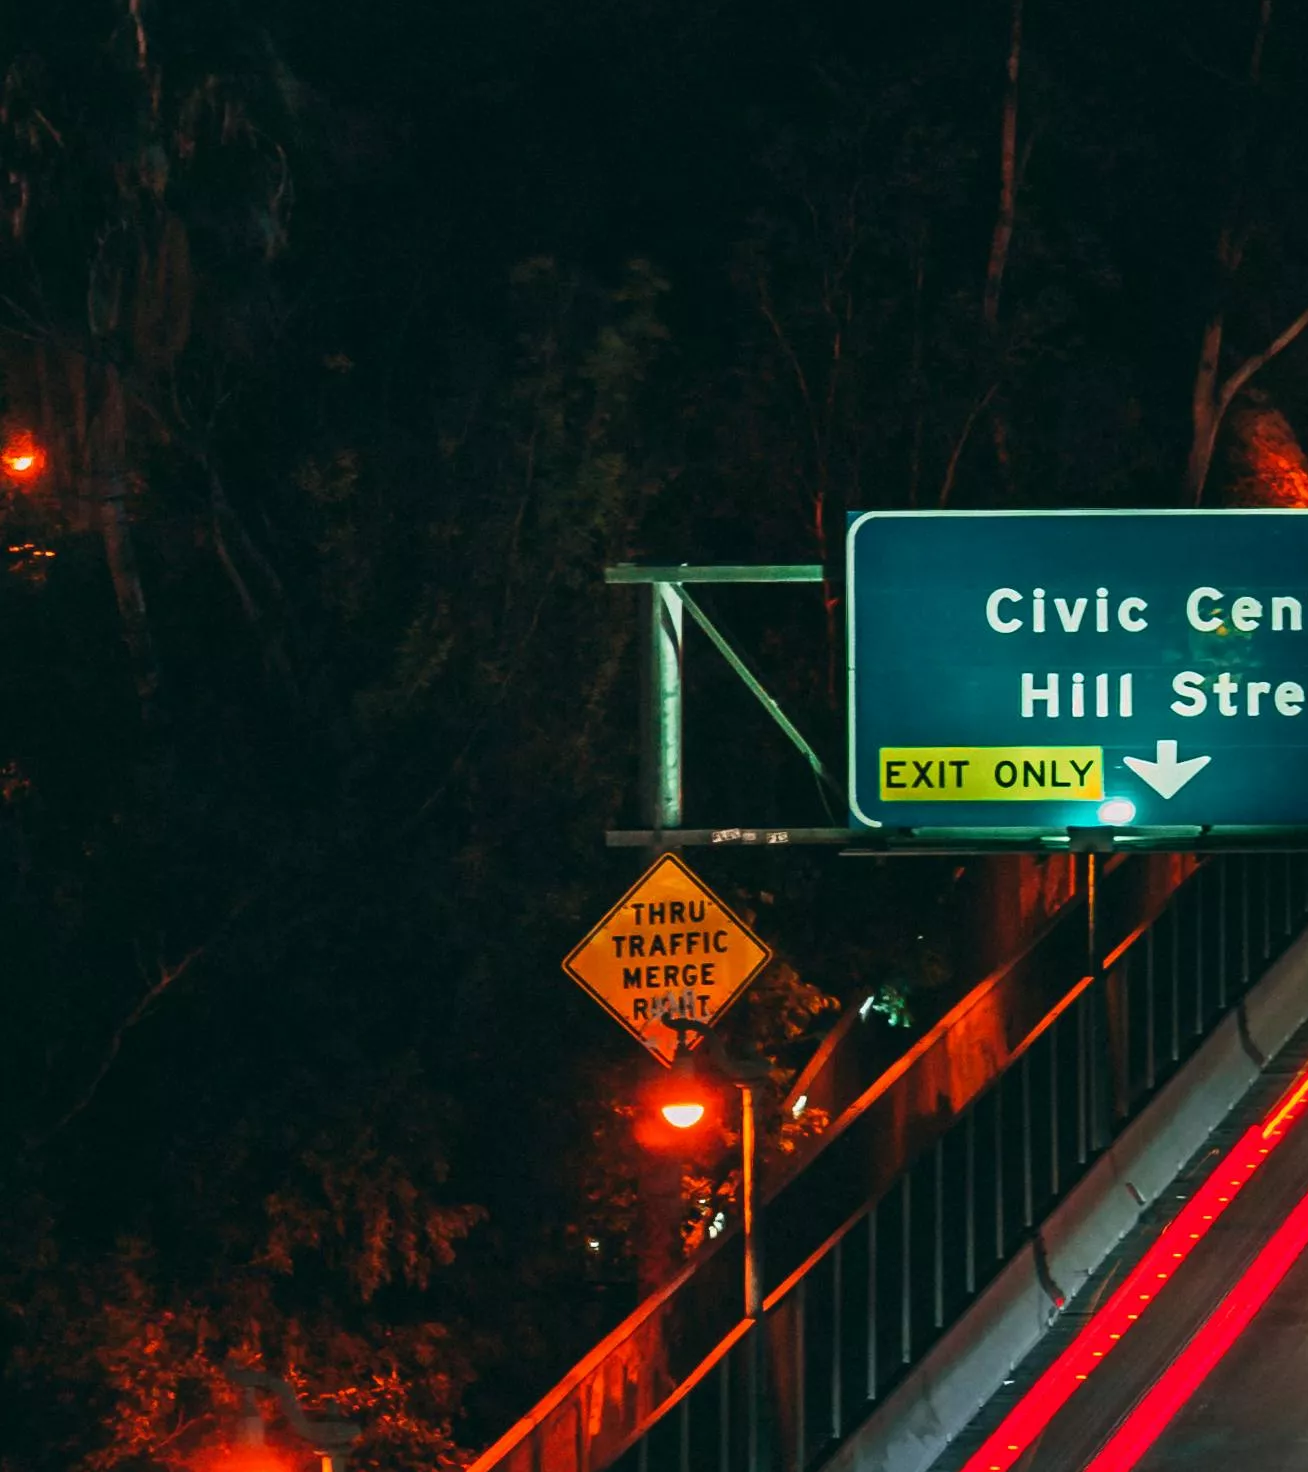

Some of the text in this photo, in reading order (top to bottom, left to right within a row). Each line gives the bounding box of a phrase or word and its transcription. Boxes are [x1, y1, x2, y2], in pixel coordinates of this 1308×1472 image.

[986, 588, 1147, 633] Civic
[1022, 673, 1132, 717] Hill
[886, 760, 1093, 788] EXIT ONLY
[632, 901, 705, 925] THRU
[612, 930, 727, 957] TRAFFIC
[623, 963, 714, 989] MERGE
